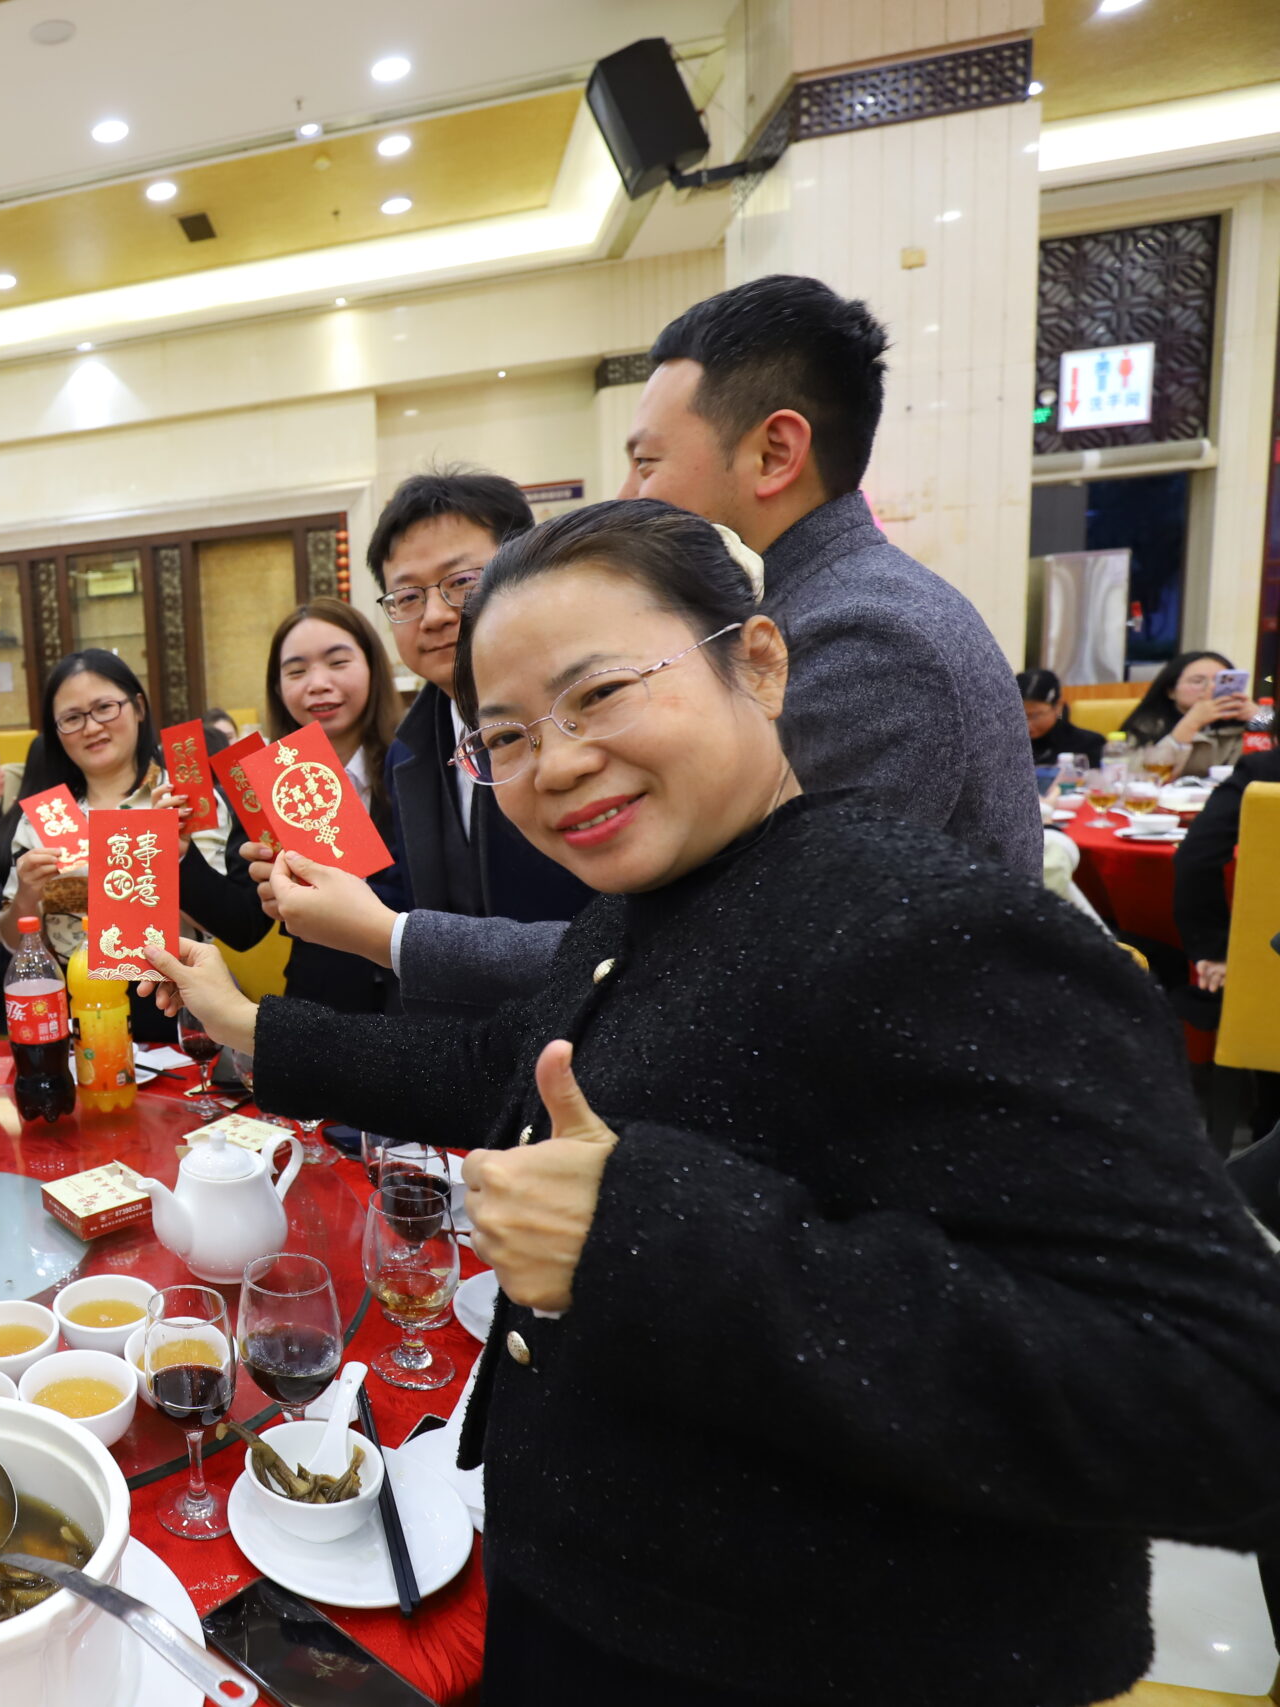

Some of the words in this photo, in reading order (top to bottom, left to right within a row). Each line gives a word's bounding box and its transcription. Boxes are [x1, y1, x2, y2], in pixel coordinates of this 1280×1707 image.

[36, 798, 67, 823] 萬事
[107, 830, 162, 869] 萬事
[103, 868, 160, 907] 如意
